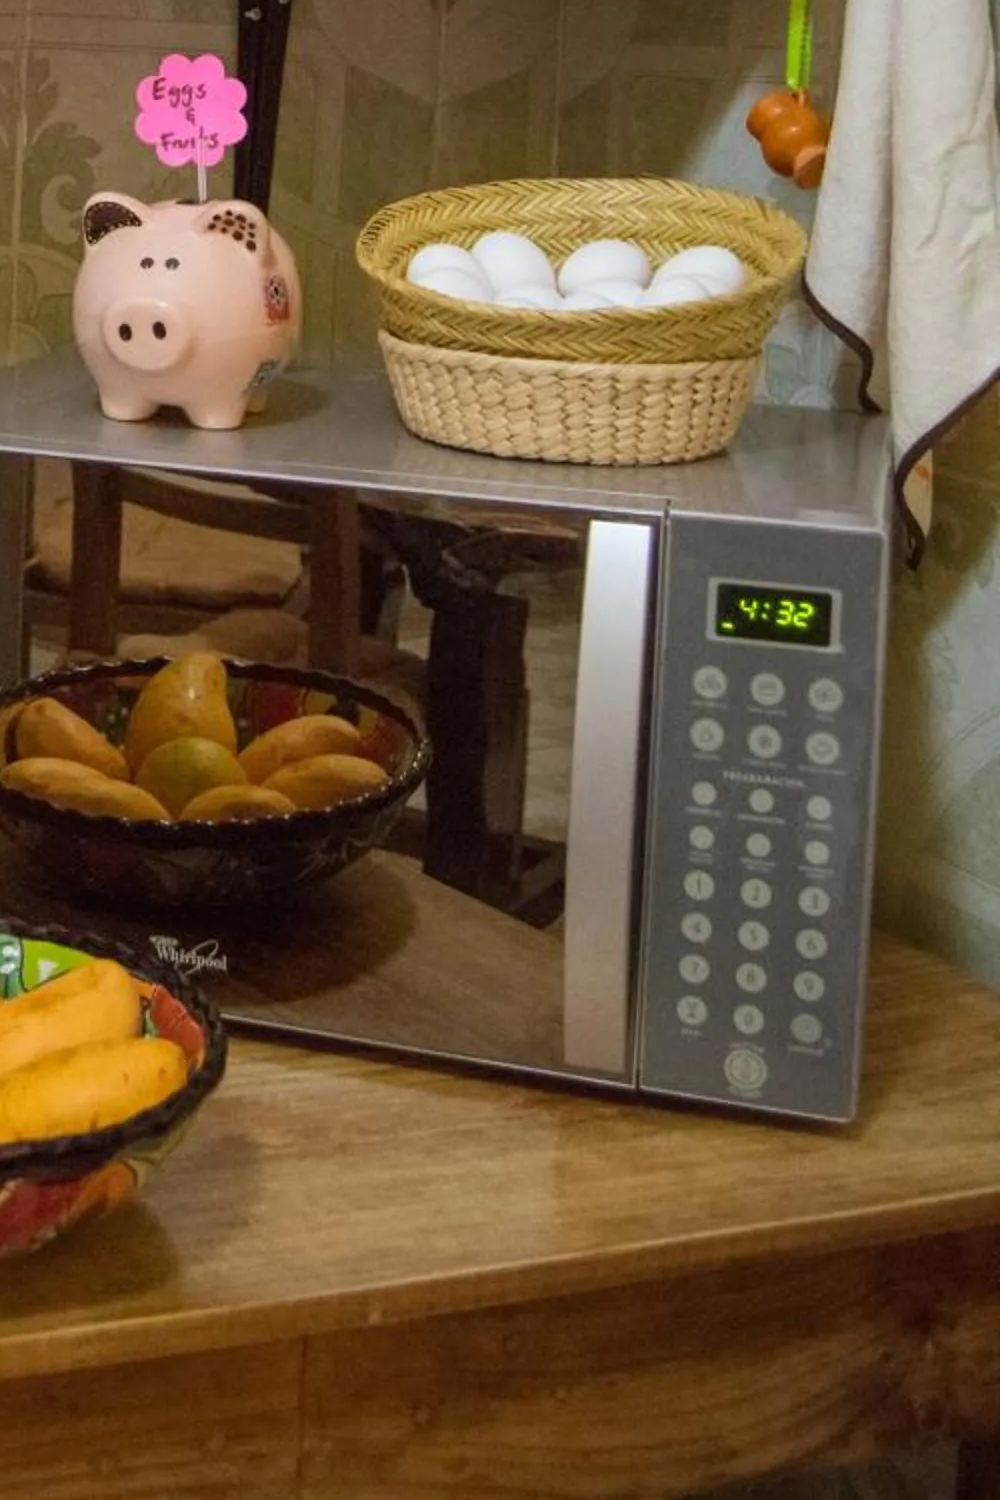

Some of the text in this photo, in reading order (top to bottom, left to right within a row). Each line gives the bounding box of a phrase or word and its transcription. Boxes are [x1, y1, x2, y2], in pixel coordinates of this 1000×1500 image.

[152, 77, 207, 108] Eggs
[740, 599, 815, 628] 4:32
[155, 941, 227, 974] Whirlpool
